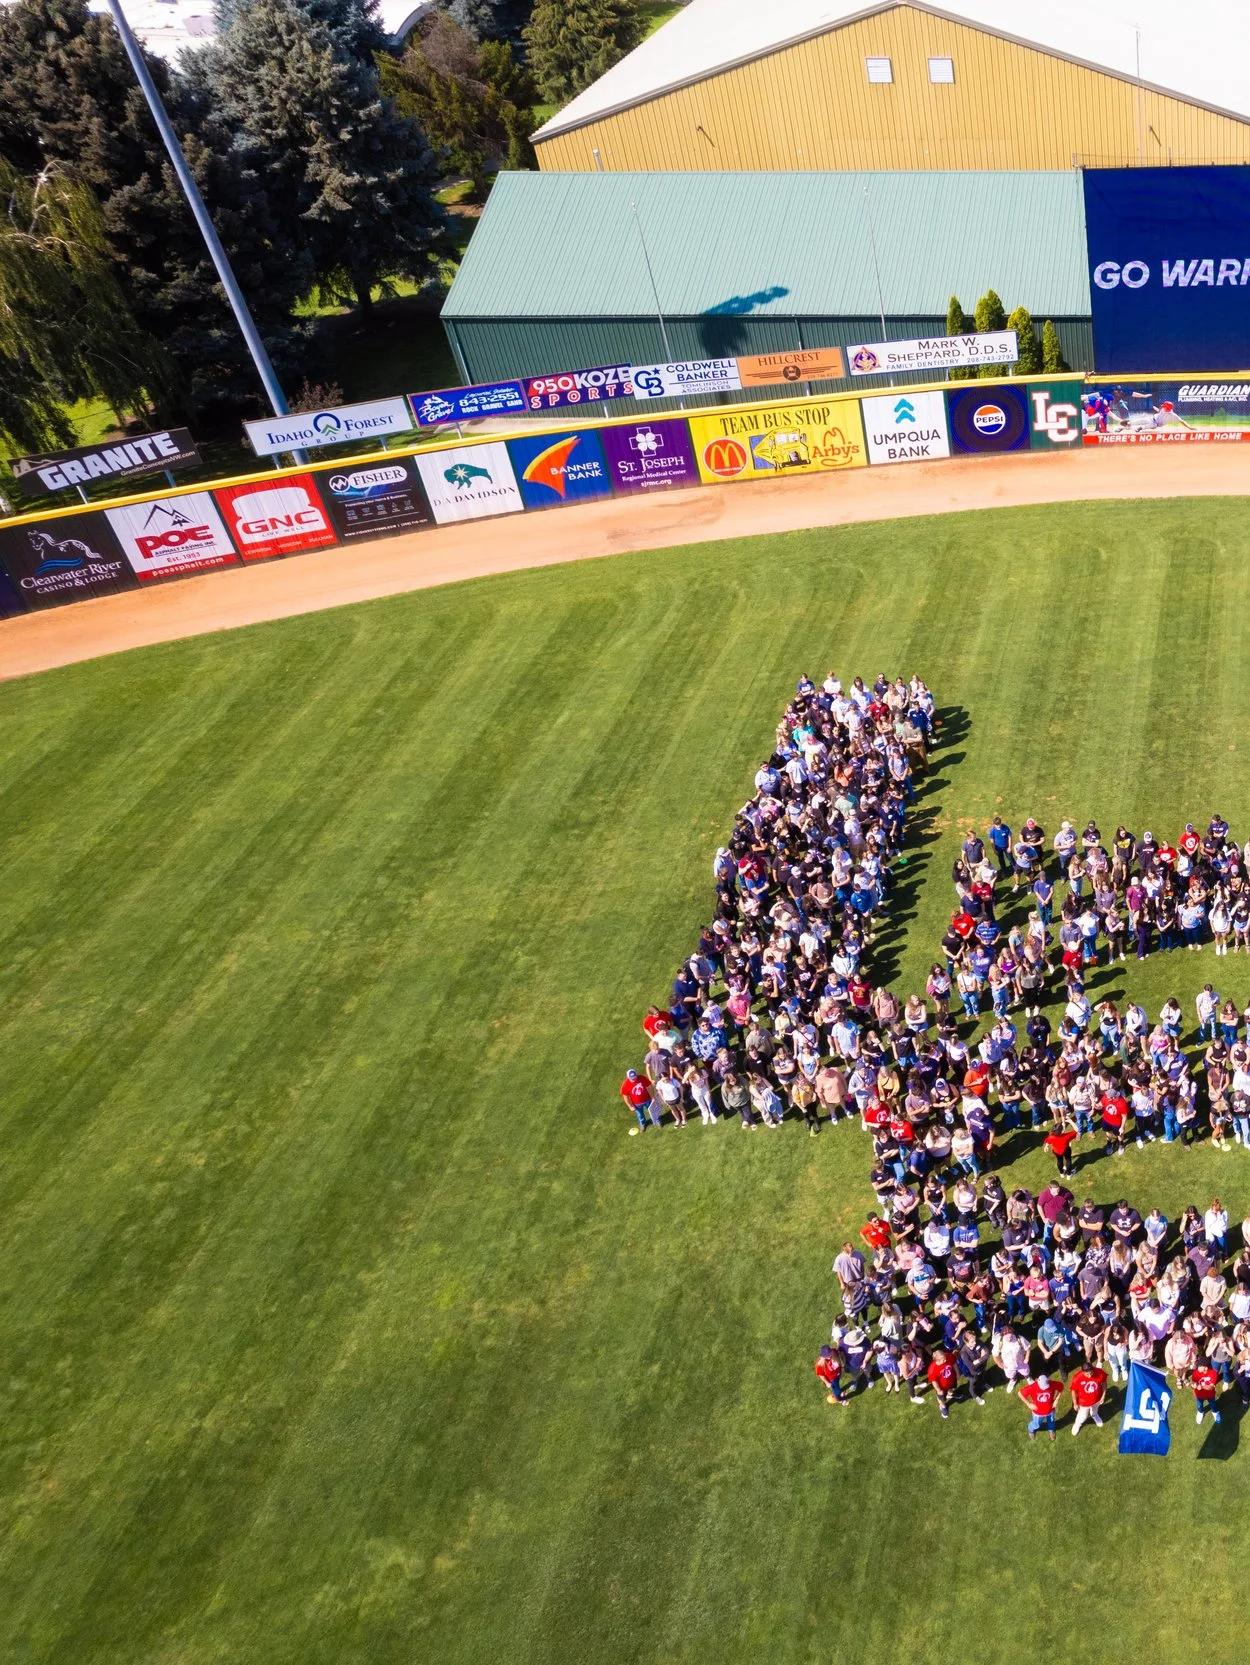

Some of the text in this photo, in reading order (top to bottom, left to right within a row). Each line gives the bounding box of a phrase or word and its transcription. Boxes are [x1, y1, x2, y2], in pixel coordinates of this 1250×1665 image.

[1093, 260, 1150, 290] GO
[917, 337, 980, 350] MARK W.
[968, 343, 1012, 356] D.D.S.
[666, 360, 736, 373] COLDWELL
[757, 352, 821, 367] HILLCREST
[886, 362, 913, 370] FAMILY
[917, 358, 959, 368] DENTISTRY
[532, 366, 631, 394] 950 KOZE
[677, 369, 728, 382] BANKER
[681, 380, 729, 389] TOMLINSON
[681, 385, 731, 393] ASSOCIATES
[530, 381, 633, 409] SPORTS
[719, 407, 831, 437] TEAM BUS STOP
[976, 415, 1004, 424] PEPSI
[266, 415, 393, 445] IDAHO FOREST
[873, 429, 942, 446] UMPQUA
[1098, 432, 1242, 443] THERE'S NO PLACE LIKE HOME
[301, 431, 365, 447] GROUP
[812, 441, 860, 459] Arby's
[887, 445, 931, 459] BANK
[36, 432, 180, 490] GRANITE
[120, 450, 196, 477] GraniteConceptsNW.com
[550, 461, 600, 475] BANNER
[352, 468, 404, 486] FISHER
[568, 469, 603, 481] BANK
[622, 474, 646, 482] Regional
[641, 479, 672, 487] sjrmc.org
[454, 486, 516, 503] DAVIDSON
[241, 510, 319, 535] GNC
[134, 524, 214, 560] POE
[154, 543, 204, 556] ASPHALT PAVING
[20, 561, 122, 589] Clearwater River
[152, 557, 224, 577] poeasphalt.com
[36, 571, 118, 594] CASINO & LODGE
